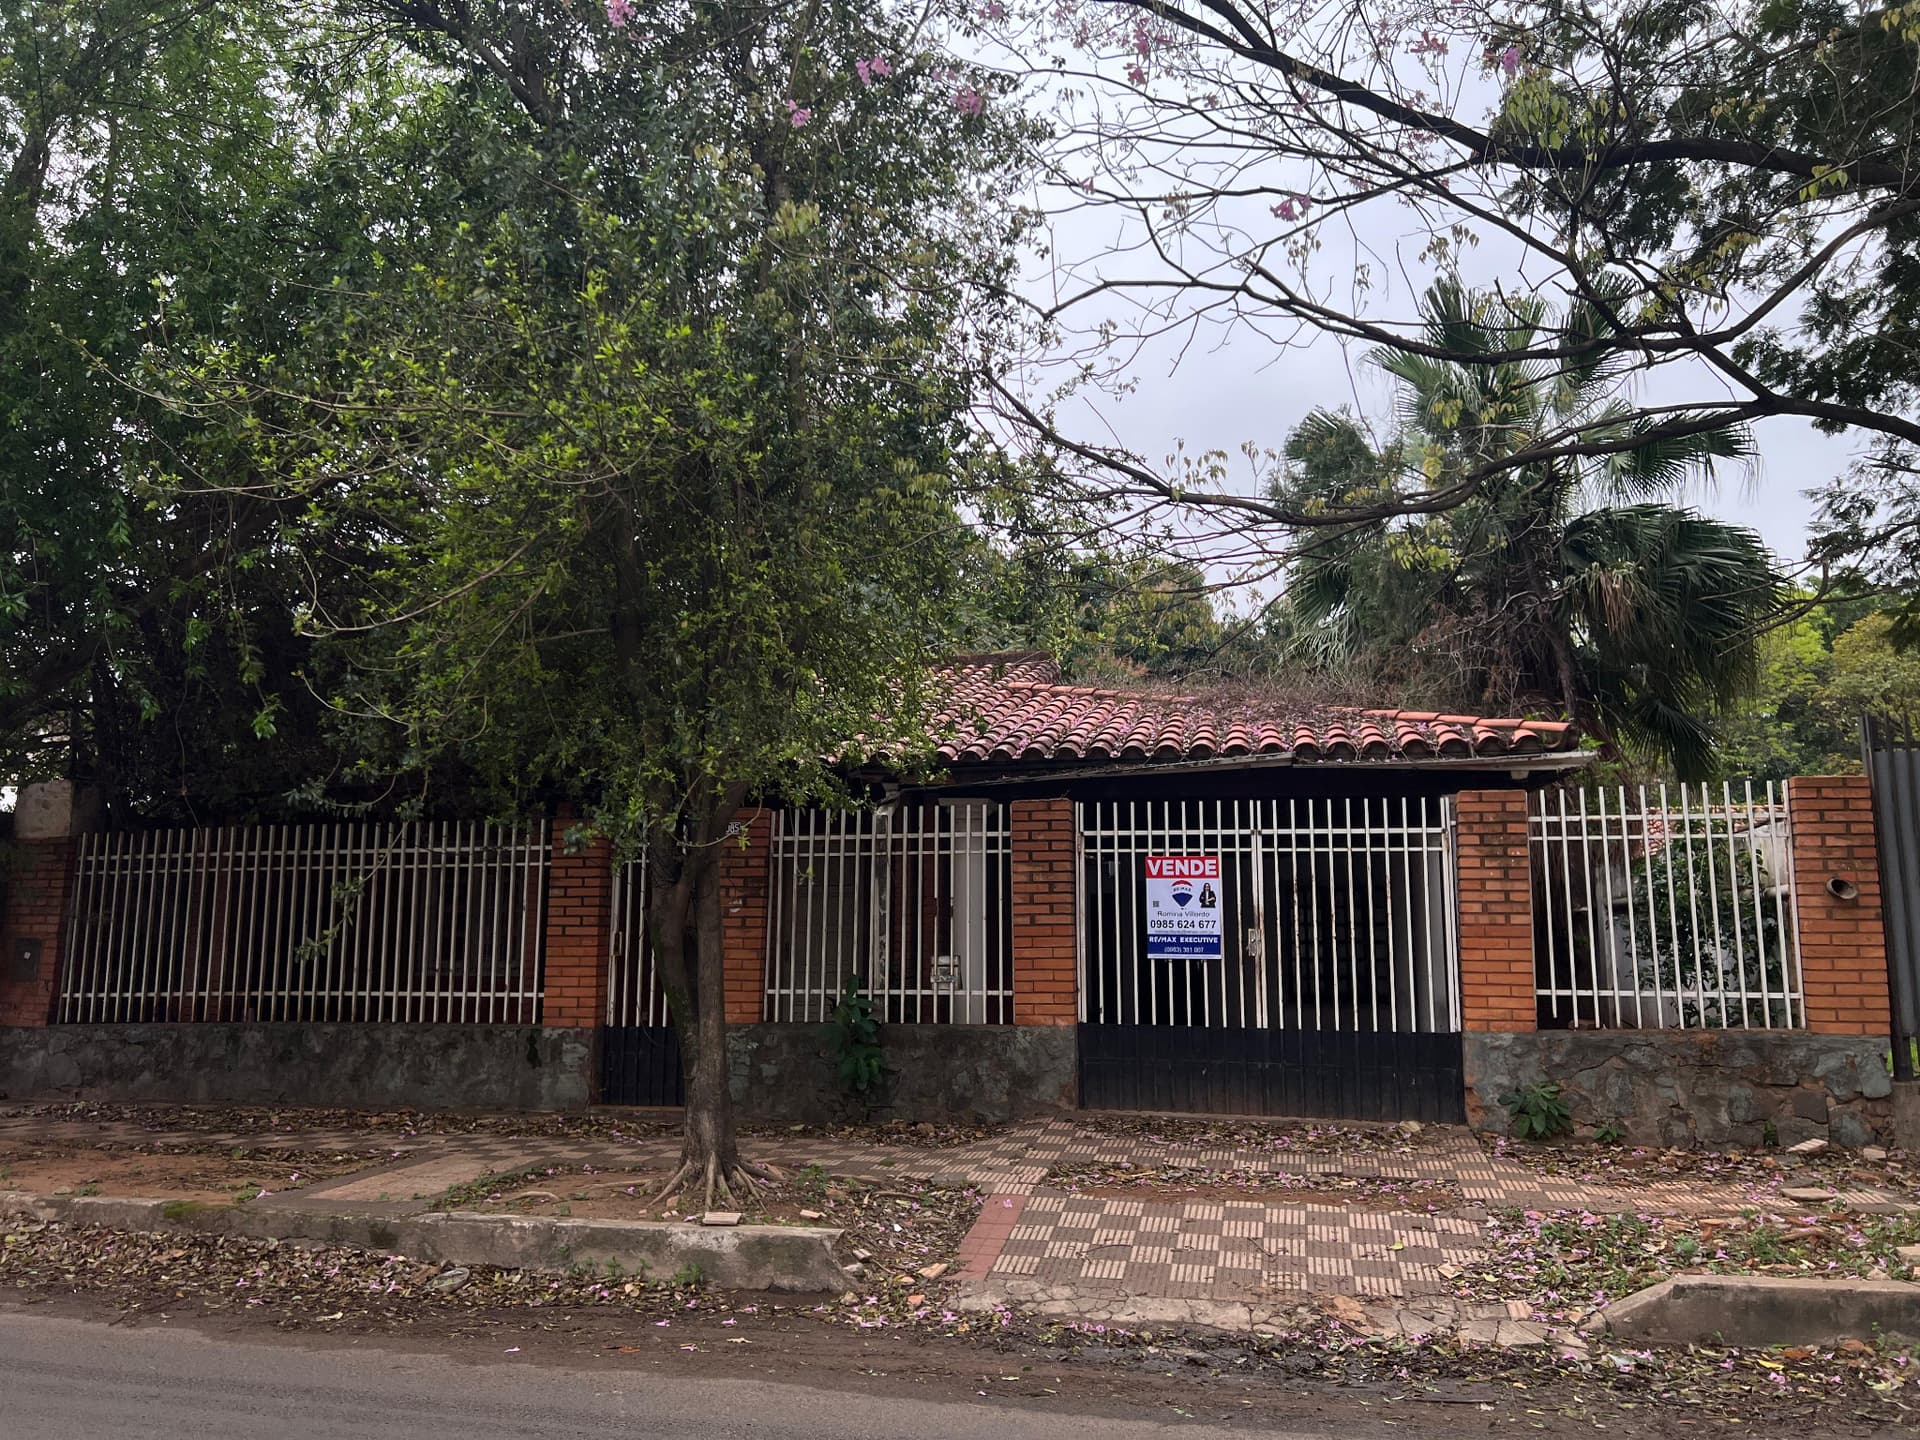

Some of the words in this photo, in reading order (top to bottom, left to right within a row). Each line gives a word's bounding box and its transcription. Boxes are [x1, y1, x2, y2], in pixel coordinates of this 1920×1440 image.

[1147, 859, 1217, 876] VENDE
[1150, 919, 1175, 929] 0985
[1177, 919, 1195, 929] 624
[1198, 919, 1217, 929] 677
[1180, 936, 1218, 944] EXECUTIVE
